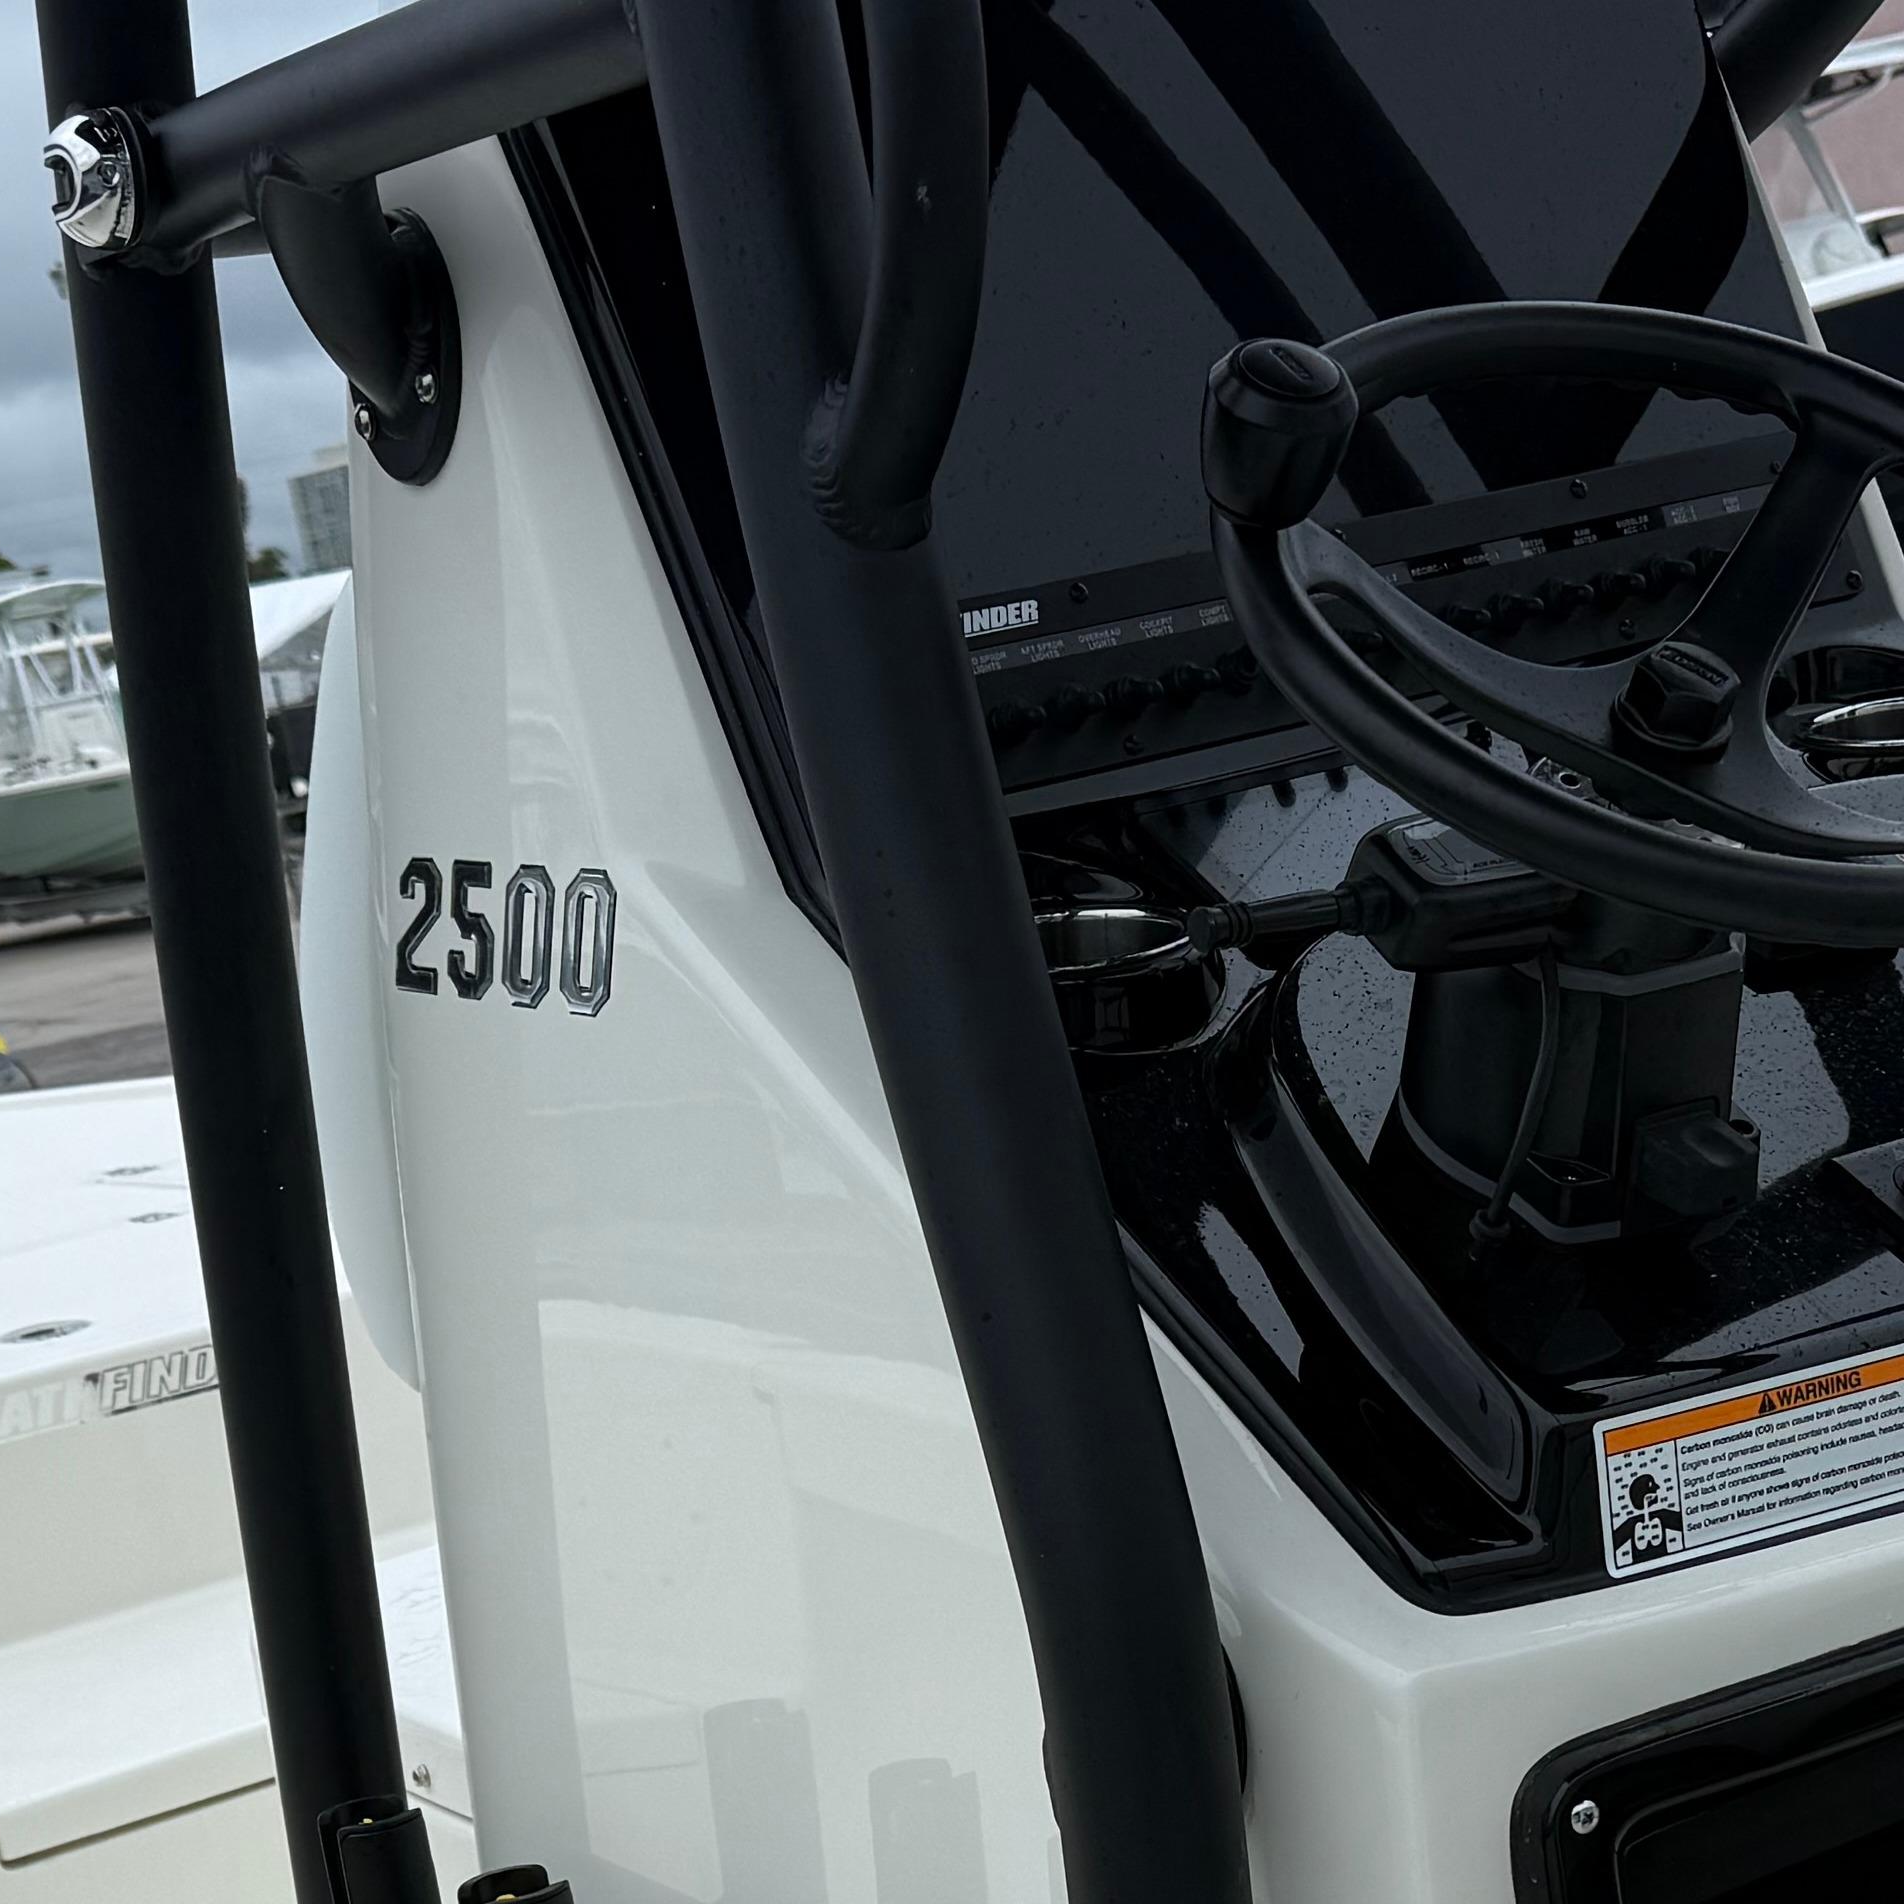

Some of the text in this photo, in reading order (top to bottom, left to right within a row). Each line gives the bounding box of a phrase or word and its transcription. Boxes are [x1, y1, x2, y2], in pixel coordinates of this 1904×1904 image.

[960, 598, 1040, 638] INDER
[1145, 625, 1175, 639] LIGHTS
[1030, 650, 1061, 664] LIGHTS
[1087, 638, 1118, 651] LIGHTS
[396, 857, 617, 1017] 2500
[1777, 1370, 1862, 1407] WARNING
[1679, 1439, 1711, 1454] Carbon
[1711, 1428, 1753, 1446] monoxide
[1754, 1423, 1774, 1436] (CO)
[1775, 1419, 1790, 1430] can
[1791, 1413, 1814, 1426] cause
[1815, 1407, 1835, 1419] brain
[1836, 1399, 1868, 1415] damage
[1868, 1397, 1877, 1406] or
[1681, 1456, 1709, 1473] Engine
[1710, 1451, 1726, 1464] and
[1727, 1443, 1764, 1460] generator
[1765, 1434, 1796, 1448] exhaust
[1796, 1425, 1829, 1440] contains
[1830, 1416, 1863, 1431] odorless
[1863, 1410, 1878, 1423] and
[1682, 1474, 1705, 1488] Signs
[1705, 1471, 1714, 1482] of
[1714, 1464, 1742, 1478] carbon
[1743, 1454, 1781, 1471] monoxide
[1781, 1444, 1819, 1462] poisoning
[1819, 1436, 1847, 1450] include
[1683, 1488, 1699, 1500] and
[1700, 1483, 1717, 1496] lack
[1717, 1480, 1726, 1491] of
[1685, 1504, 1699, 1516] Get
[1699, 1499, 1719, 1511] fresh
[1736, 1488, 1765, 1503] anyone
[1765, 1480, 1790, 1493] shows
[1790, 1475, 1810, 1488] signs
[1811, 1471, 1820, 1482] of
[1820, 1465, 1846, 1479] carbon
[1847, 1456, 1882, 1472] monoxide
[1686, 1519, 1702, 1532] See
[1703, 1511, 1735, 1527] Owner's
[1736, 1503, 1765, 1518] Manual
[1766, 1499, 1776, 1510] for
[1777, 1488, 1821, 1506] information
[1821, 1478, 1858, 1496] regarding
[1859, 1471, 1885, 1484] carbon
